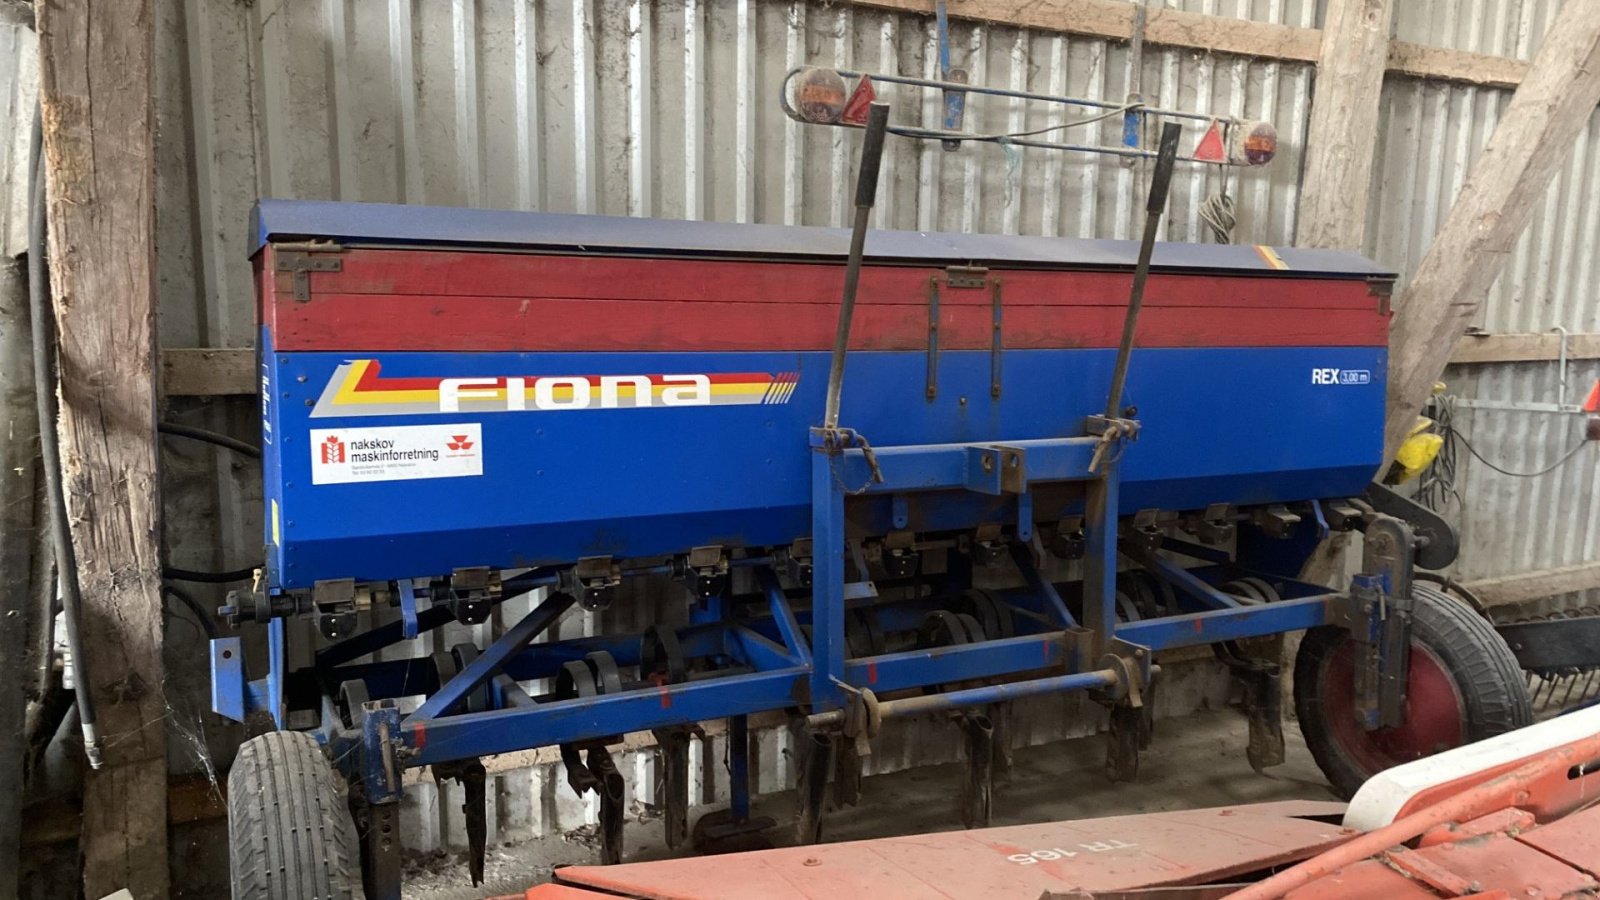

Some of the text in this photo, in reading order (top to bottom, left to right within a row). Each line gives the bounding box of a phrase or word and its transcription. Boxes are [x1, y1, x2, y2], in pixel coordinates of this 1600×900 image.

[1312, 368, 1340, 384] REX
[351, 438, 395, 450] nakskov
[351, 448, 439, 463] maskinforretning
[1007, 839, 1139, 865] TR 165
